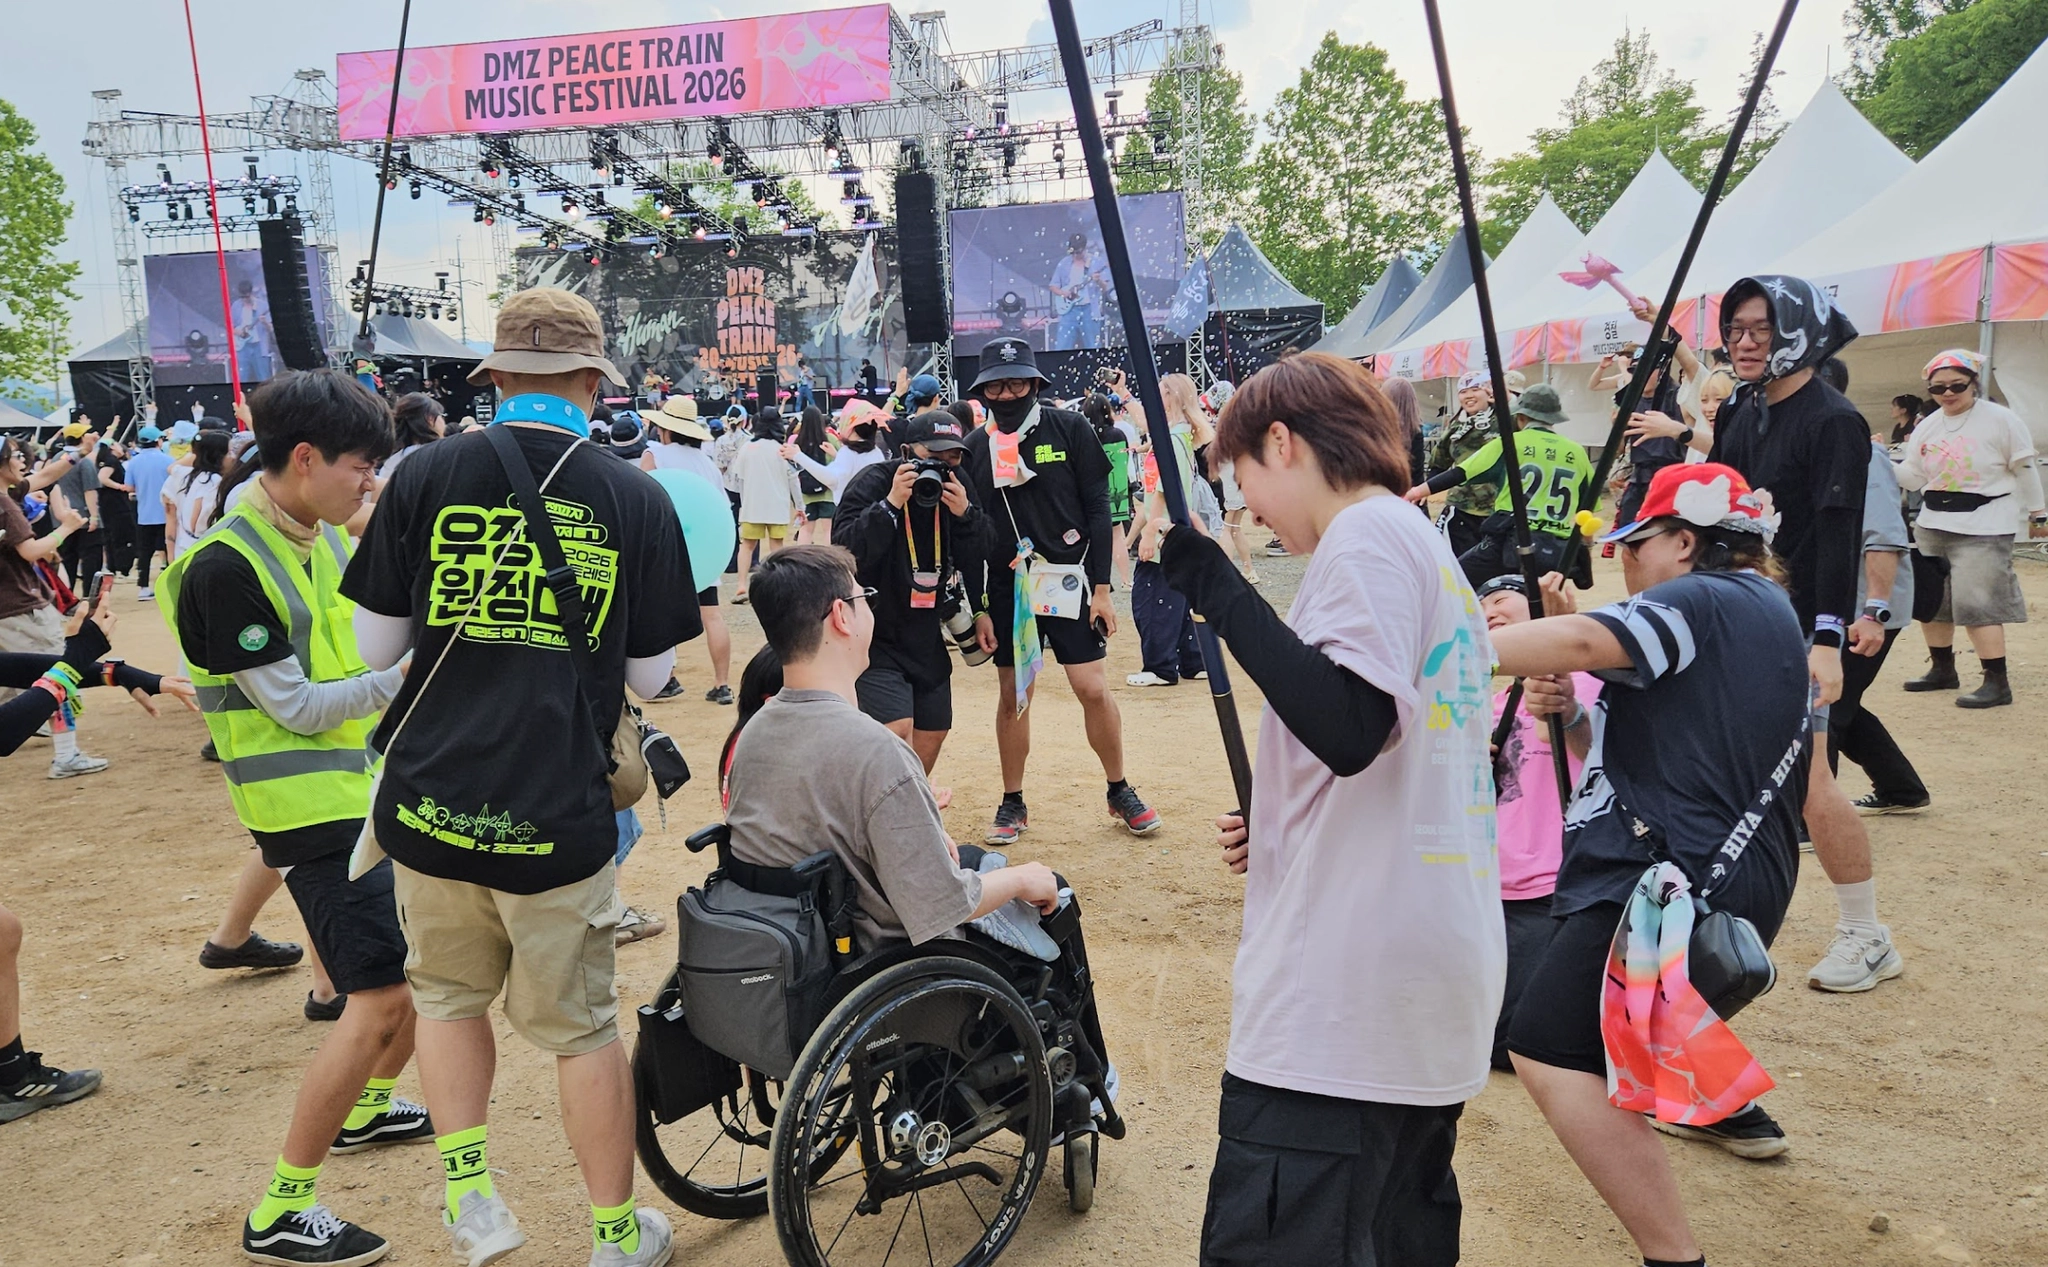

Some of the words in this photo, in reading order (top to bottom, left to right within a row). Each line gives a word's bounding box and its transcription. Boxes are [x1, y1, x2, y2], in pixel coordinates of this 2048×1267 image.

[484, 48, 541, 82] DMZ
[548, 41, 632, 77] PEACE
[639, 31, 724, 69] TRAIN
[465, 83, 546, 120] MUSIC
[553, 73, 677, 114] FESTIVAL
[683, 67, 746, 104] 2026
[726, 266, 765, 297] DMZ
[616, 310, 686, 358] Human
[717, 296, 776, 329] PEACE
[717, 325, 776, 355] TRAIN
[1519, 463, 1576, 523] 25
[564, 548, 612, 568] 2026
[1771, 739, 1802, 788] HIYA
[1720, 811, 1763, 862] HIYA
